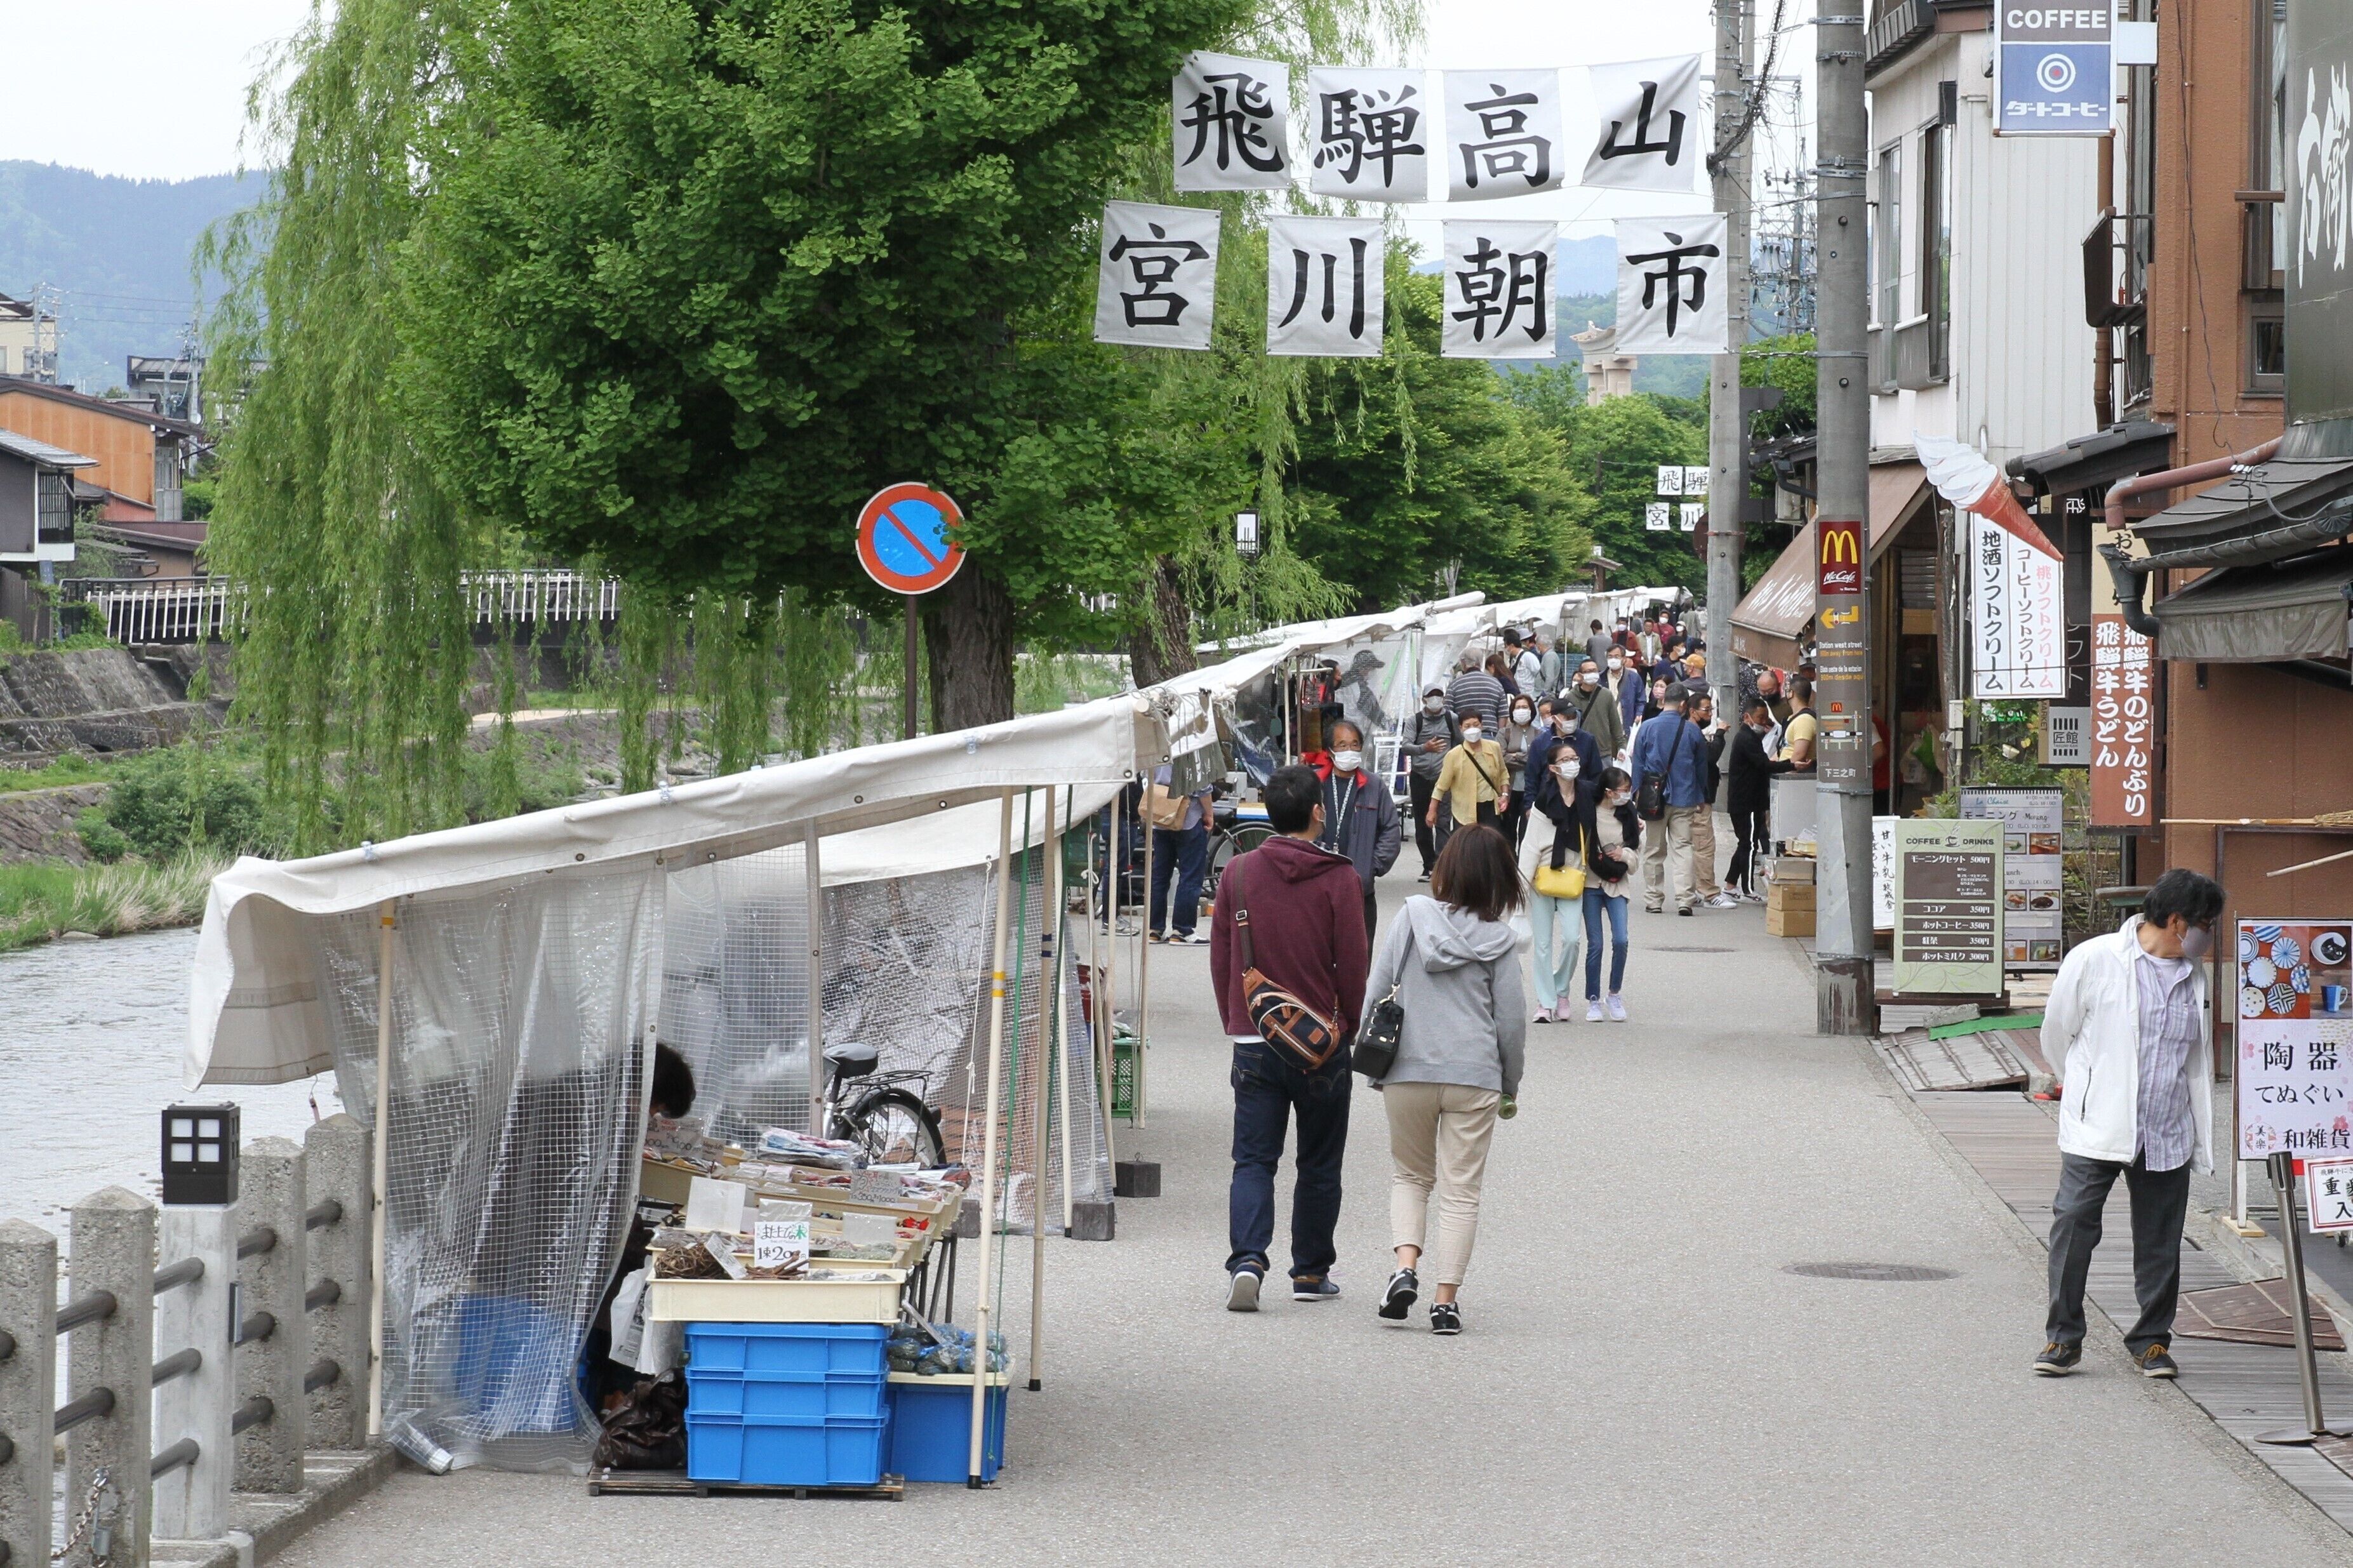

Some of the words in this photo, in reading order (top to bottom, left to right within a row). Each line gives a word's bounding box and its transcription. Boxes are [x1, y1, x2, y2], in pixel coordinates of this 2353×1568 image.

[2006, 10, 2107, 29] COFFEE
[2005, 100, 2107, 117] ダートコーヒー
[1181, 72, 1686, 189] 飛騨高山
[1109, 222, 1720, 343] 宮川朝市
[1648, 506, 1701, 526] 宮川
[1982, 530, 2004, 691] 地酒ソフトクリーム
[2017, 548, 2035, 689] コーヒーソフトクリーム
[2036, 566, 2053, 689] 桃ソフトクリーム
[2095, 621, 2121, 767] 飛騨牛うどん
[2053, 731, 2078, 744] 匠館
[1825, 768, 1856, 778] 下三之町
[1964, 810, 2020, 820] モーニング
[1911, 854, 1966, 863] モーニングセット
[1970, 856, 1990, 864] 500円
[1970, 905, 1990, 914] 350円
[1922, 936, 1938, 945] 紅茶
[1970, 937, 1990, 945] 350円
[1922, 952, 1966, 960] ホットミルク
[2263, 1041, 2338, 1072] 陶器
[2255, 1084, 2343, 1105] てぬぐい
[2283, 1128, 2350, 1150] 和雑貨
